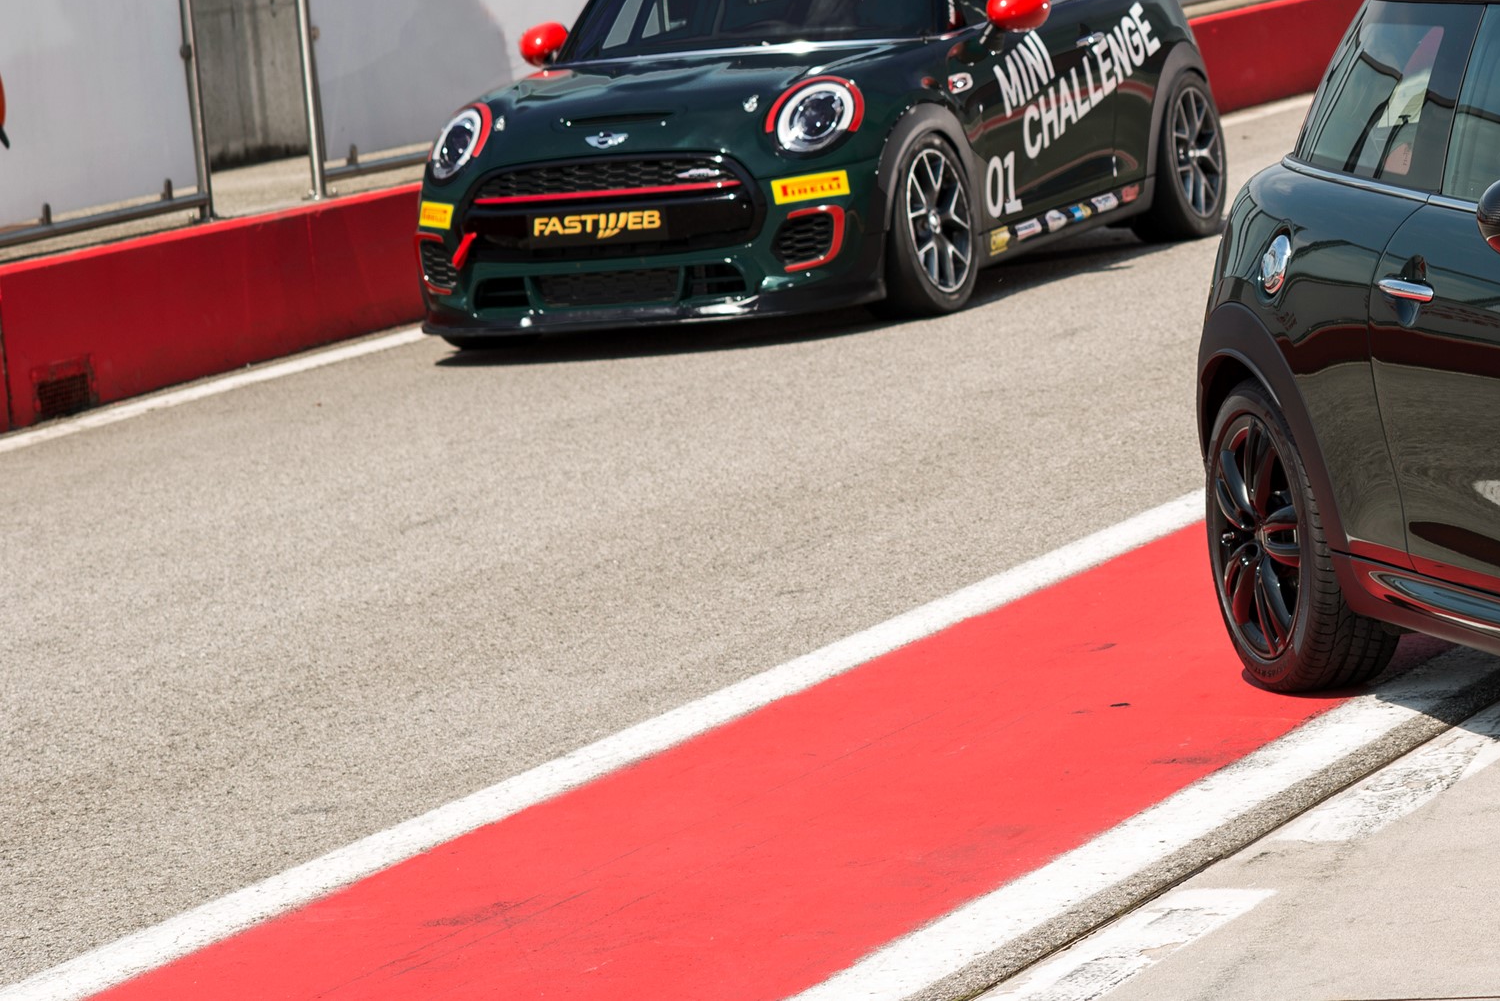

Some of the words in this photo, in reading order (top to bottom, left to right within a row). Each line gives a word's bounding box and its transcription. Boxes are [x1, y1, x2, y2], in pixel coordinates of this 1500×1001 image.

[993, 30, 1055, 118] MINI
[1023, 1, 1161, 159] CHALLENGE
[985, 151, 1023, 218] 01
[533, 210, 661, 239] FASTWEB
